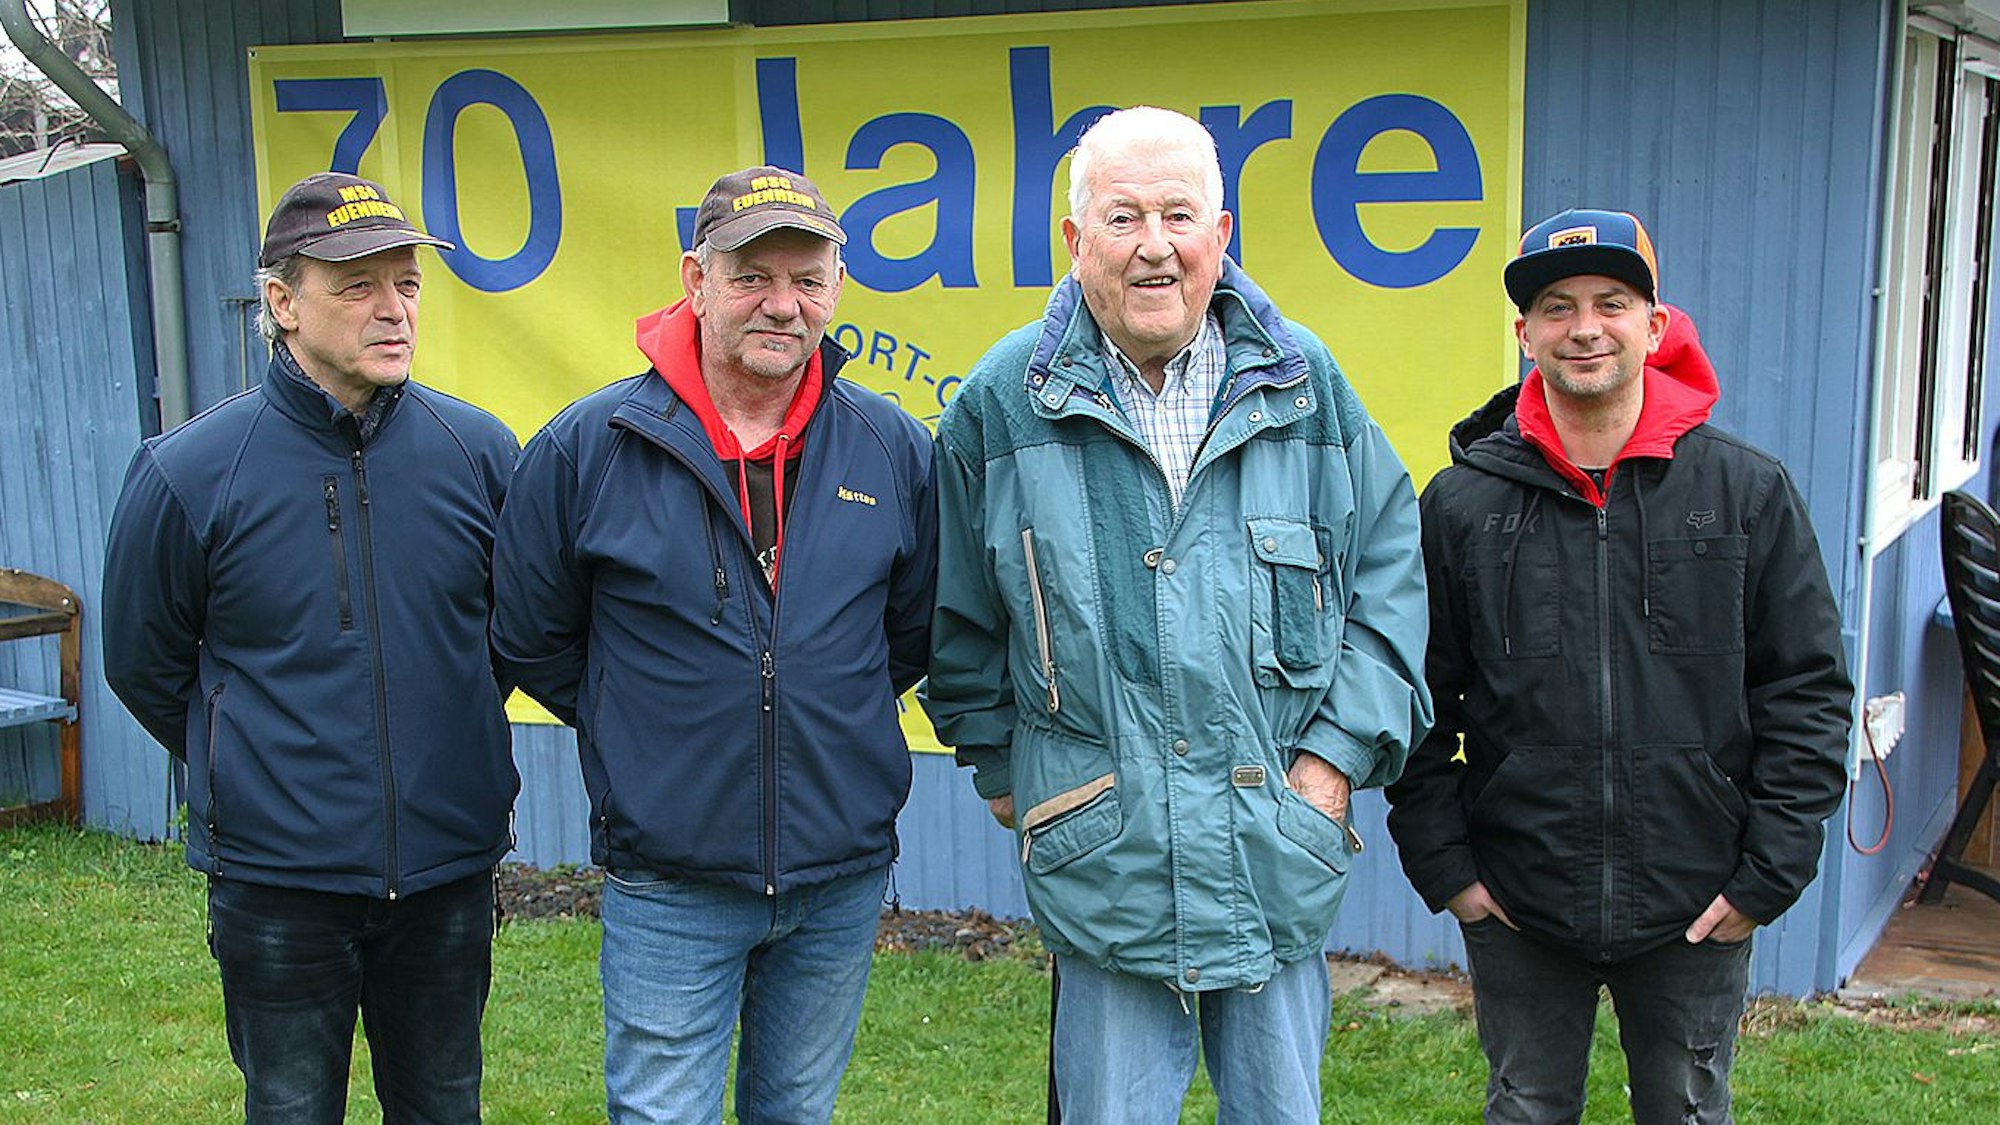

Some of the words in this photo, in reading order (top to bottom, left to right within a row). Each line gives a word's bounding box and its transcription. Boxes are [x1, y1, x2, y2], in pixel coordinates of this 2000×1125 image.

[274, 68, 562, 293] 70
[676, 46, 1483, 292] Jahre
[1482, 513, 1543, 534] FOX
